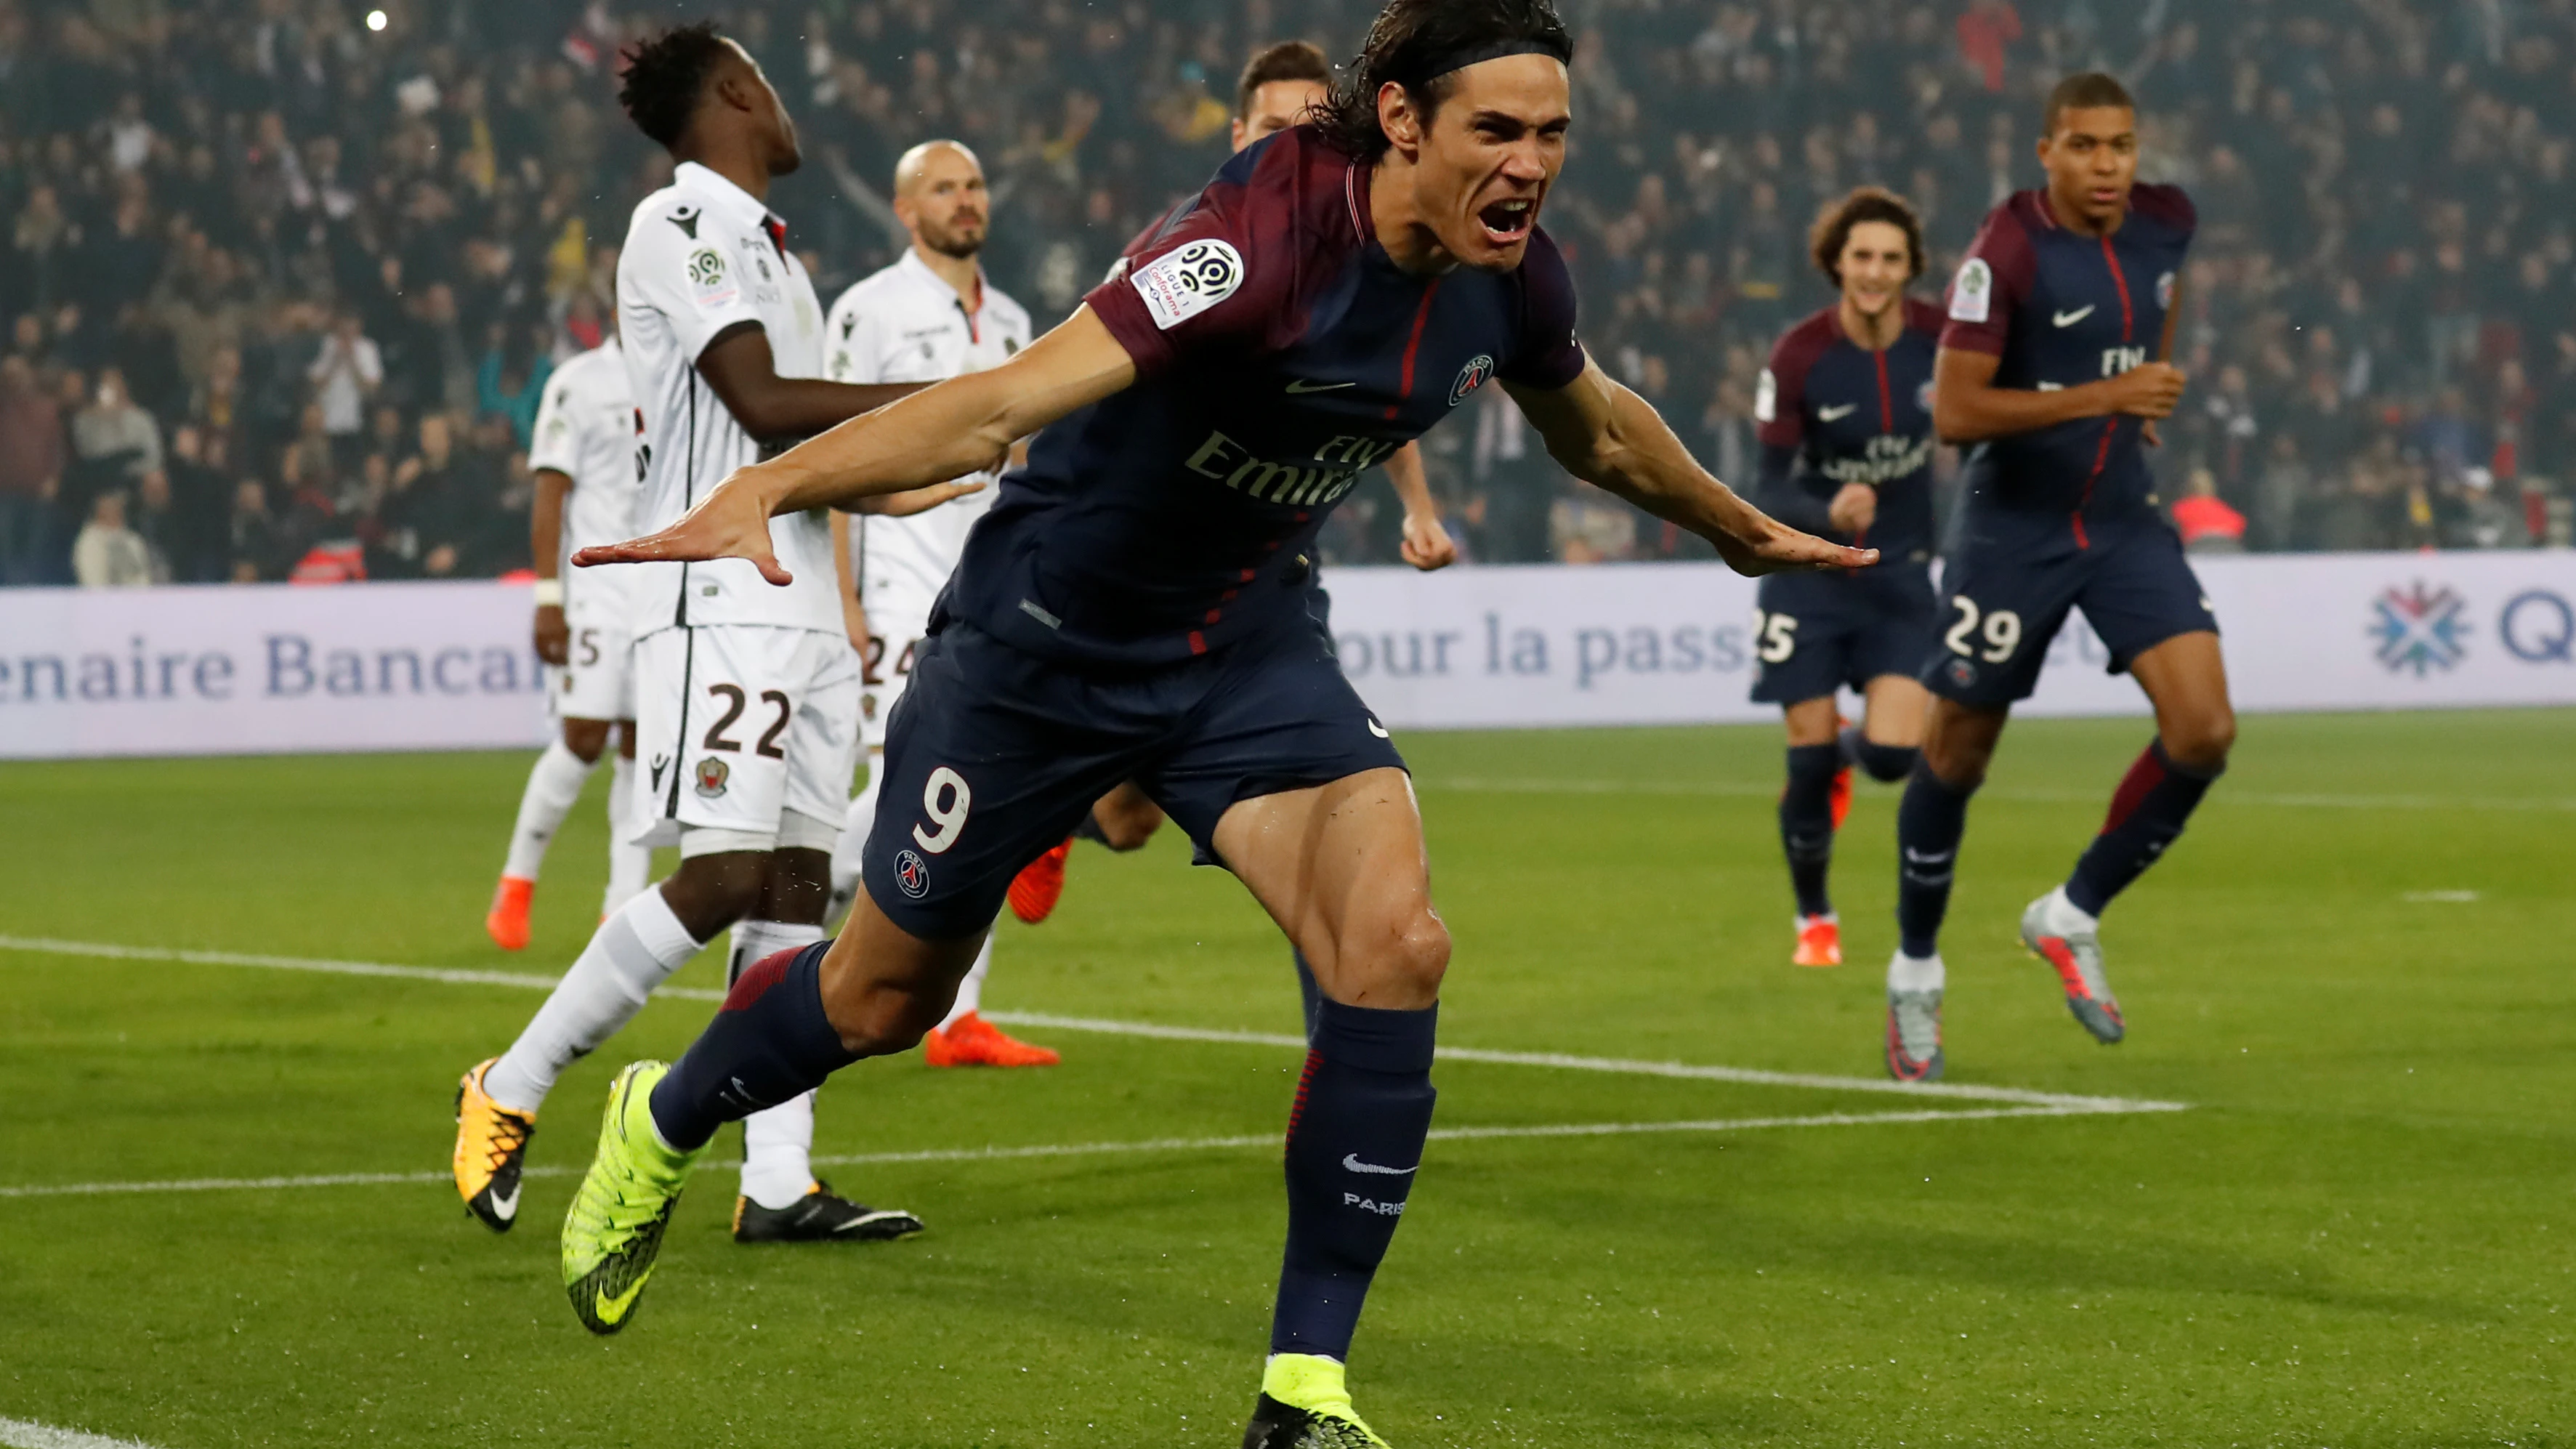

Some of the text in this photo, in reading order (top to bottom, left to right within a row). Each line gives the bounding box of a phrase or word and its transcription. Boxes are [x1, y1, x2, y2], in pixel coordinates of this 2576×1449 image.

[1149, 266, 1181, 317] Conforama
[1161, 265, 1184, 298] LIGUE
[1313, 435, 1394, 471] Fly
[1482, 609, 1552, 677] la
[1944, 594, 2022, 663] 29
[862, 636, 916, 686] 24
[702, 683, 791, 761] 22
[912, 764, 972, 855] 9
[1344, 1192, 1407, 1216] PARIS
